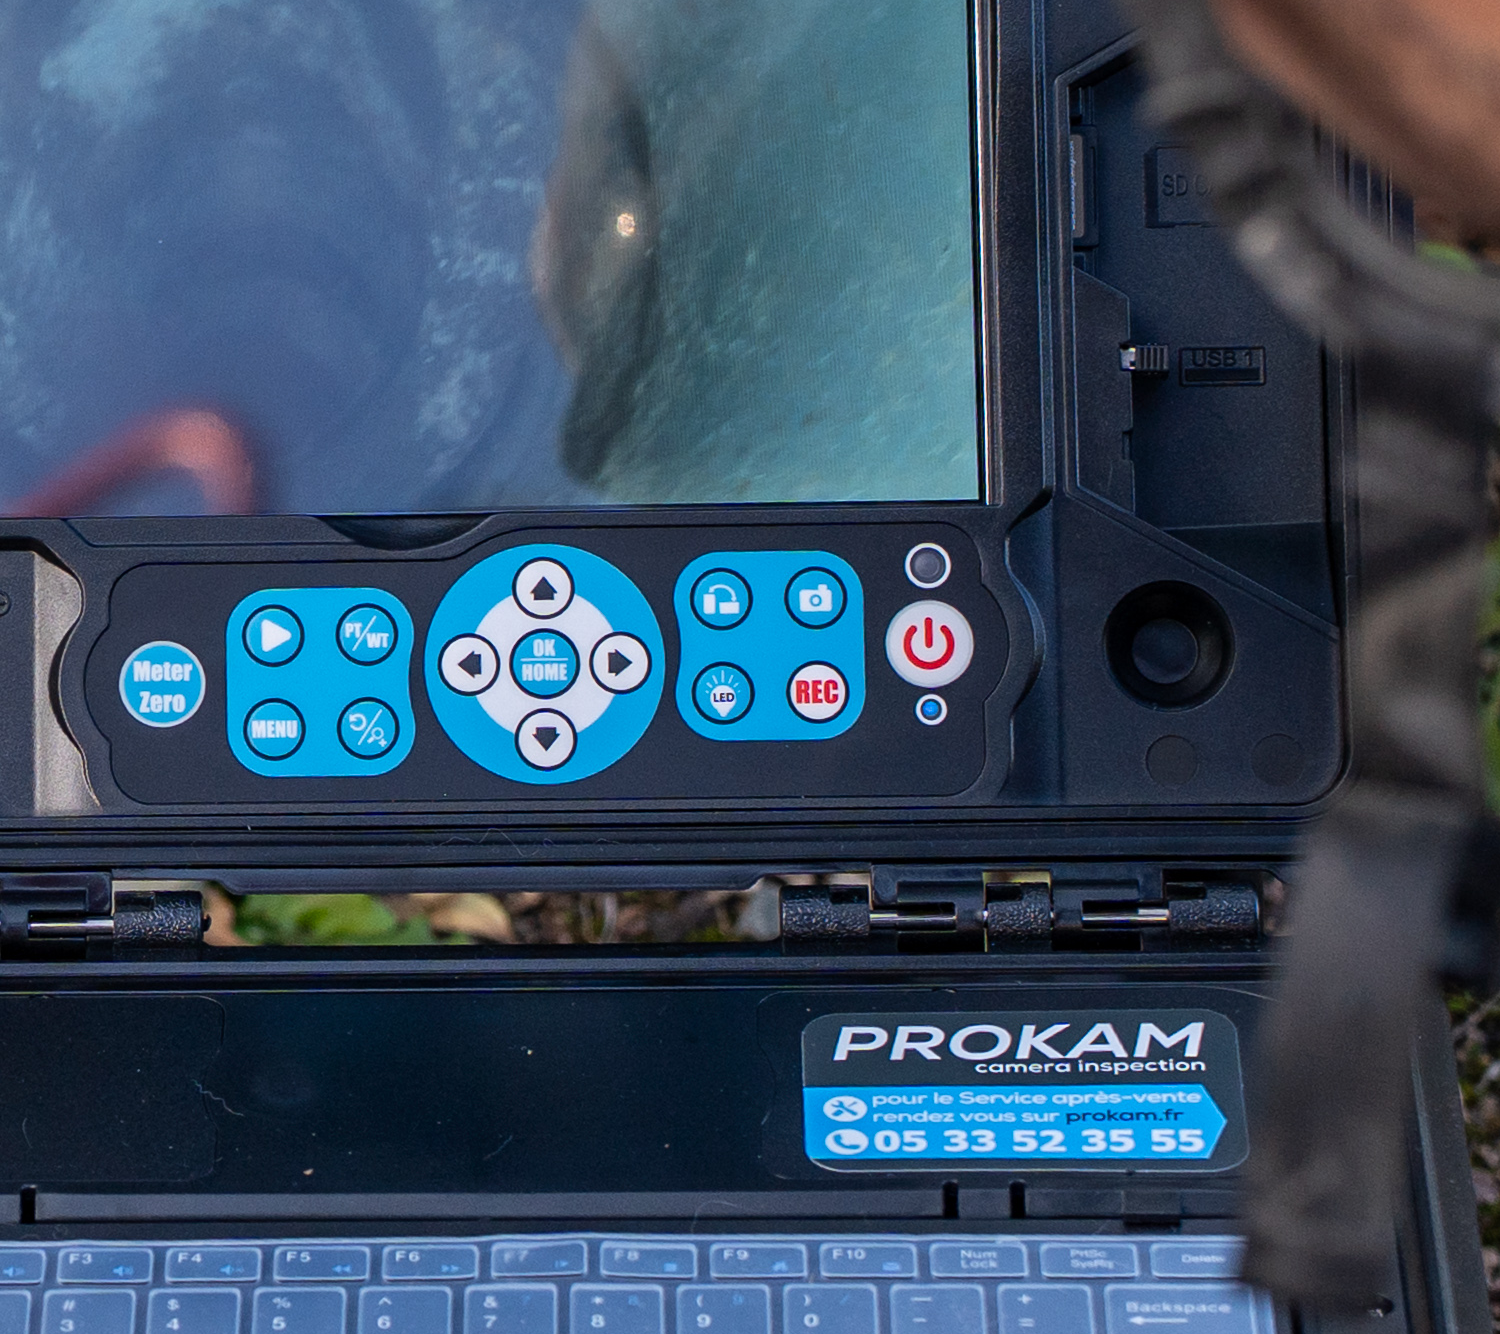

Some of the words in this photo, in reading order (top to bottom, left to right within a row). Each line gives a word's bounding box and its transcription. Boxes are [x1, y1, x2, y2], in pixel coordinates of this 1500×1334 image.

[1163, 174, 1189, 196] SD
[1191, 350, 1236, 366] USB
[532, 639, 556, 657] OK
[133, 661, 193, 682] Meter
[521, 663, 568, 681] HOME
[713, 692, 735, 703] LED
[795, 679, 839, 704] REC
[139, 691, 186, 713] Zero
[252, 720, 298, 739] MENU
[833, 1021, 1205, 1061] PROKAM
[975, 1061, 1071, 1074] camera
[1078, 1059, 1206, 1075] inspection
[873, 1094, 927, 1108] pour
[934, 1092, 953, 1105] le
[959, 1090, 1047, 1105] Service
[1053, 1089, 1201, 1107] après-vente
[873, 1109, 954, 1123] rendez
[962, 1111, 1016, 1123] vous
[1023, 1111, 1059, 1123] sur
[1066, 1108, 1184, 1125] prokam.fr
[874, 1129, 928, 1153] 05
[943, 1129, 997, 1153] 33
[1012, 1129, 1067, 1153] 52
[1081, 1129, 1135, 1153] 35
[1151, 1129, 1205, 1152] 55
[69, 1253, 92, 1264] F3
[178, 1252, 201, 1263] F4
[286, 1251, 311, 1262] F5
[396, 1250, 420, 1262] F6
[504, 1249, 529, 1263] F7
[614, 1249, 639, 1261] F8
[723, 1249, 749, 1260] F9
[832, 1249, 866, 1260] F10
[960, 1249, 997, 1258] Num
[960, 1260, 997, 1268] Lock
[63, 1300, 75, 1311] #
[168, 1299, 179, 1311] $
[273, 1297, 291, 1308] %
[484, 1296, 497, 1308] &
[1126, 1302, 1231, 1314] Backspace
[60, 1319, 74, 1332] 3
[167, 1318, 179, 1330] 4
[273, 1317, 286, 1330] 5
[377, 1316, 391, 1329] 6
[484, 1315, 497, 1328] 7
[591, 1314, 605, 1327] 8
[697, 1314, 711, 1327] 9
